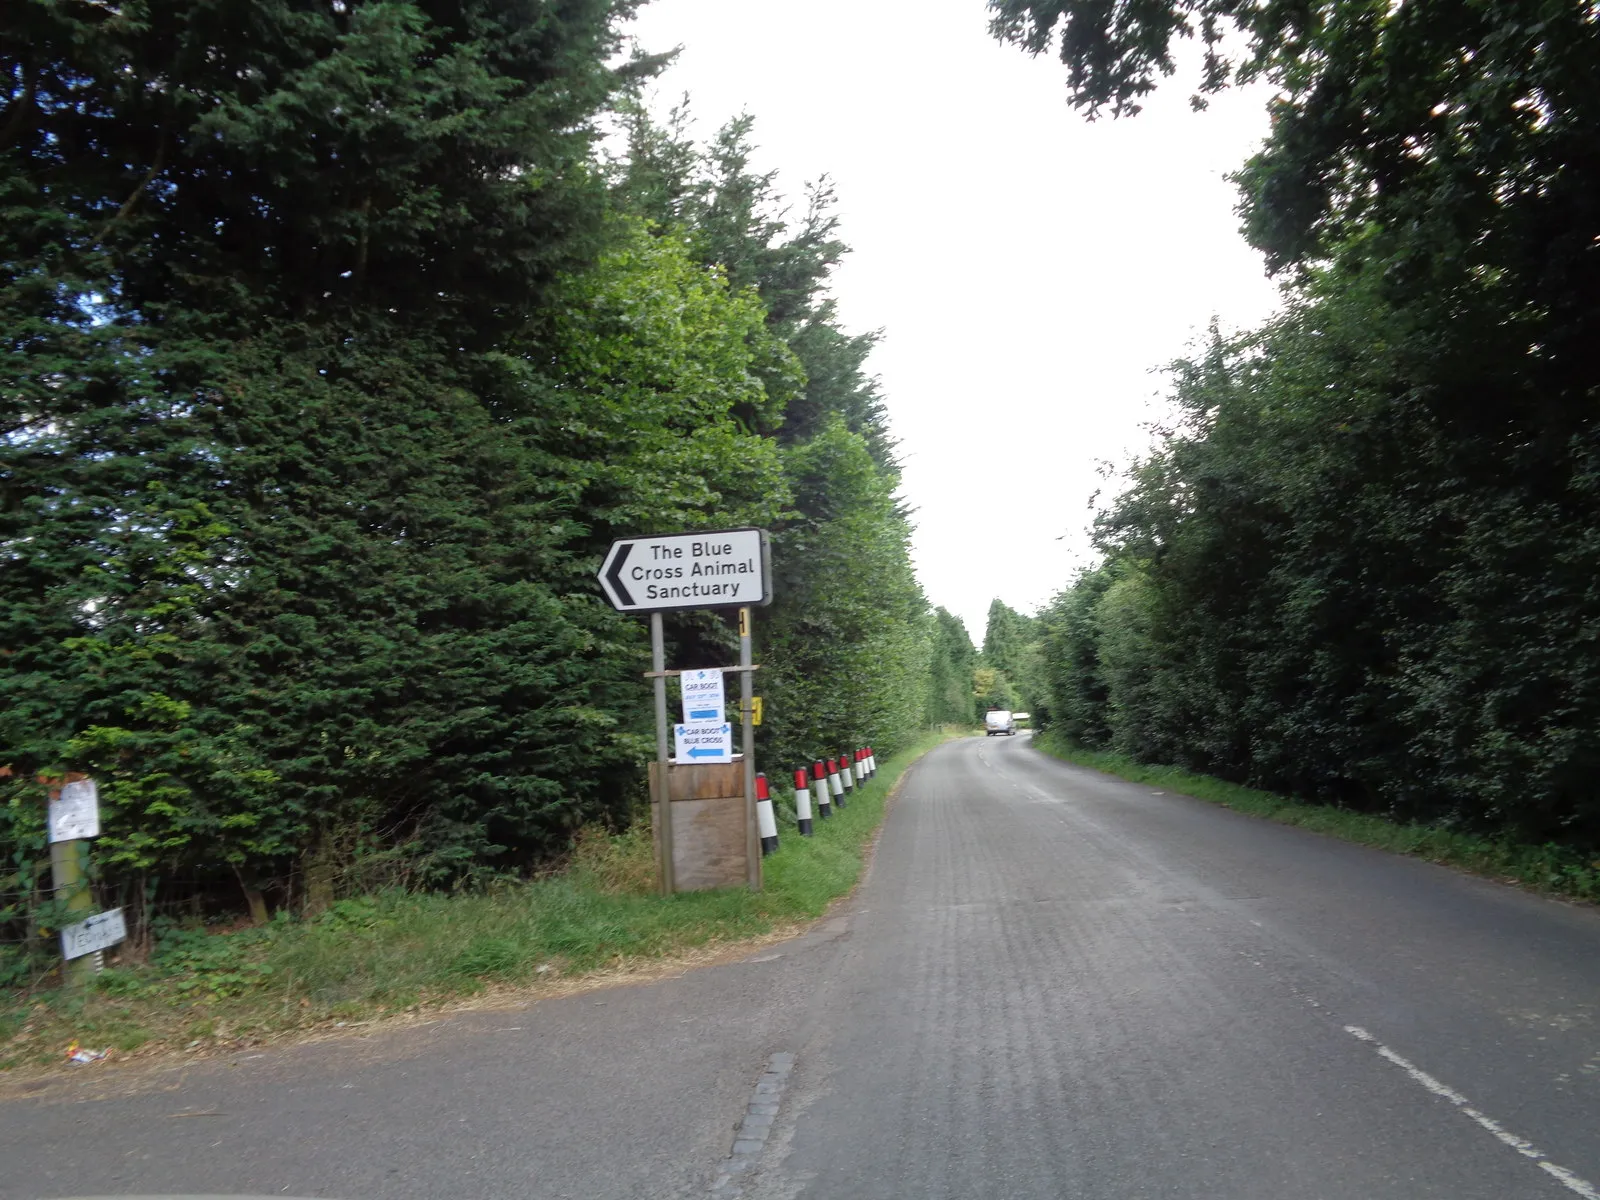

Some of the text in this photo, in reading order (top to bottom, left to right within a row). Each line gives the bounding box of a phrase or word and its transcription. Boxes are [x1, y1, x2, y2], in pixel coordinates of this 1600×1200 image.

[650, 542, 732, 559] The Blue
[631, 559, 754, 581] Cross Animal
[646, 581, 741, 600] Sanctuary
[685, 682, 718, 691] CAR BOOT
